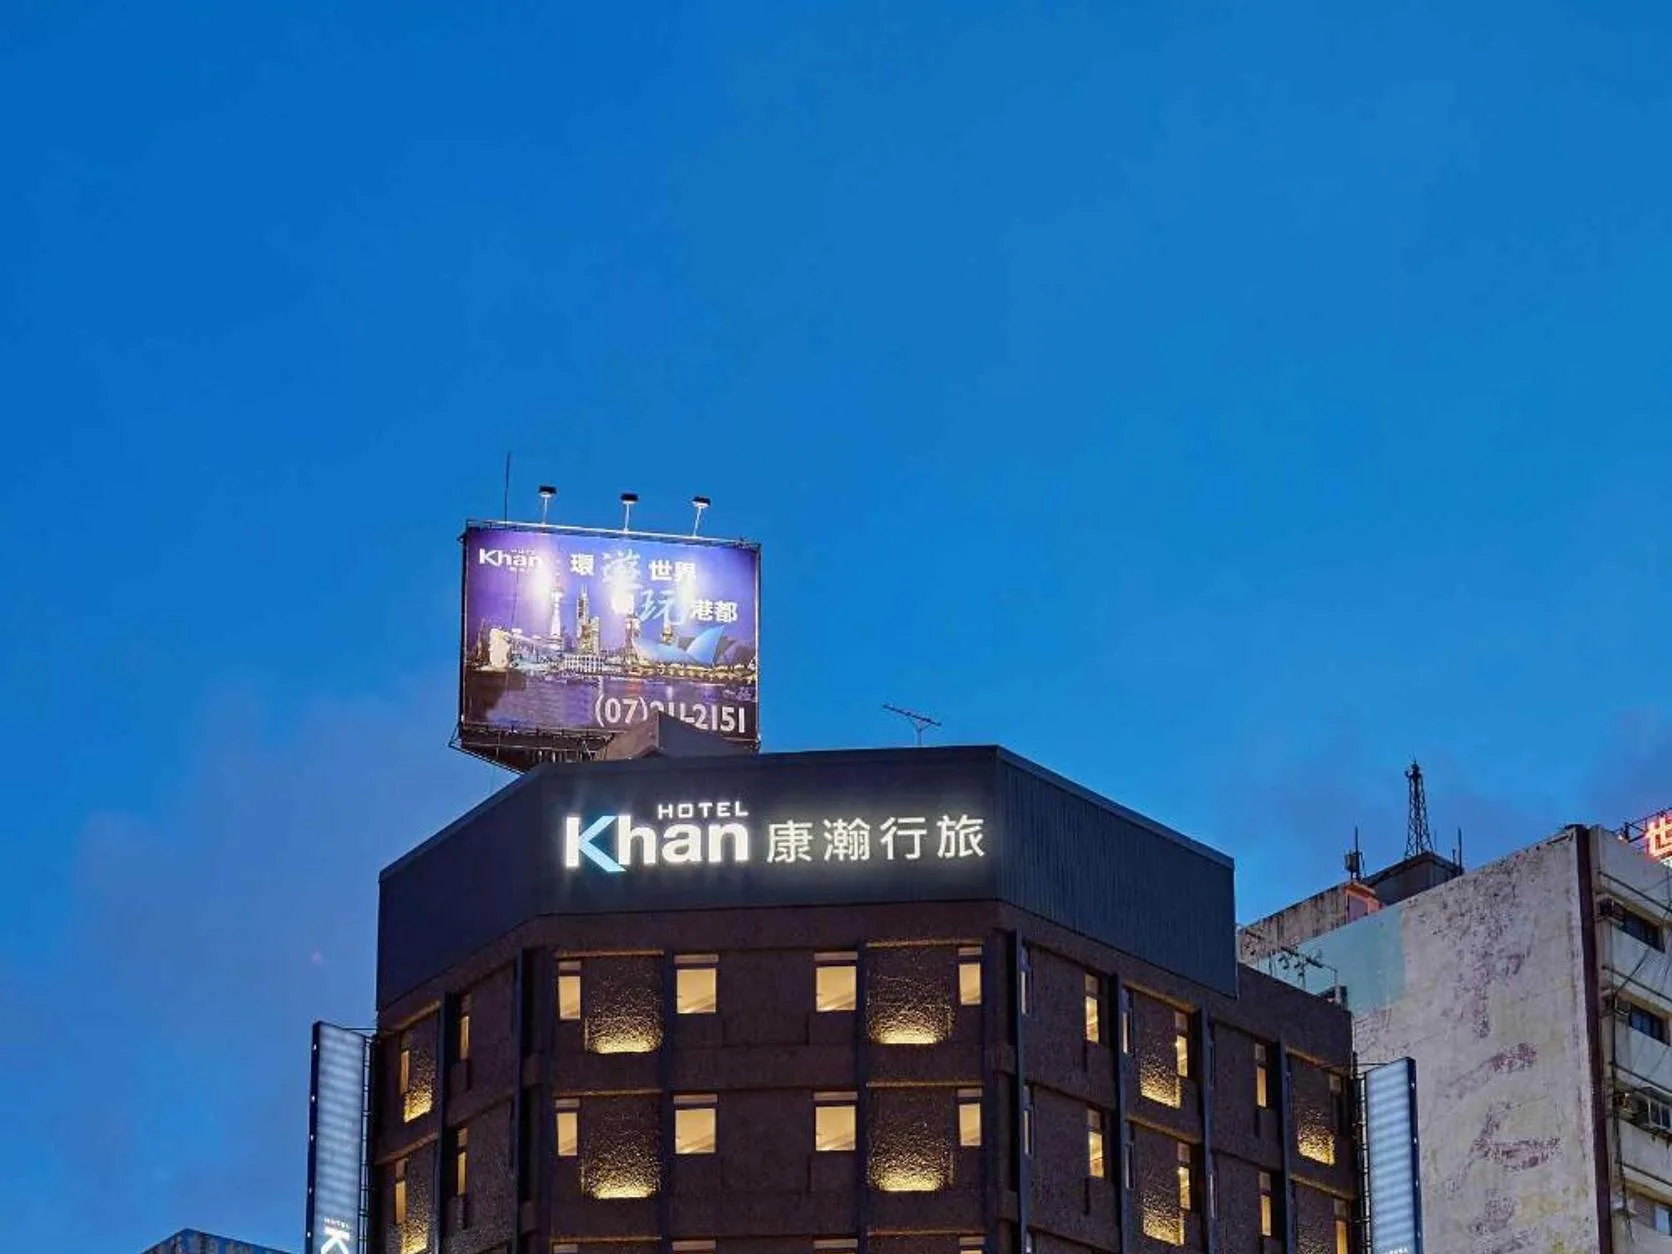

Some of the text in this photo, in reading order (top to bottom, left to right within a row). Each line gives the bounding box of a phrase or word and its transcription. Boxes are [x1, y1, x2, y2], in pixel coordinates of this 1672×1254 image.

[479, 548, 544, 567] Khan
[658, 801, 748, 819] HOTEL
[565, 814, 748, 873] Khan
[766, 813, 986, 864] 康瀚行旅
